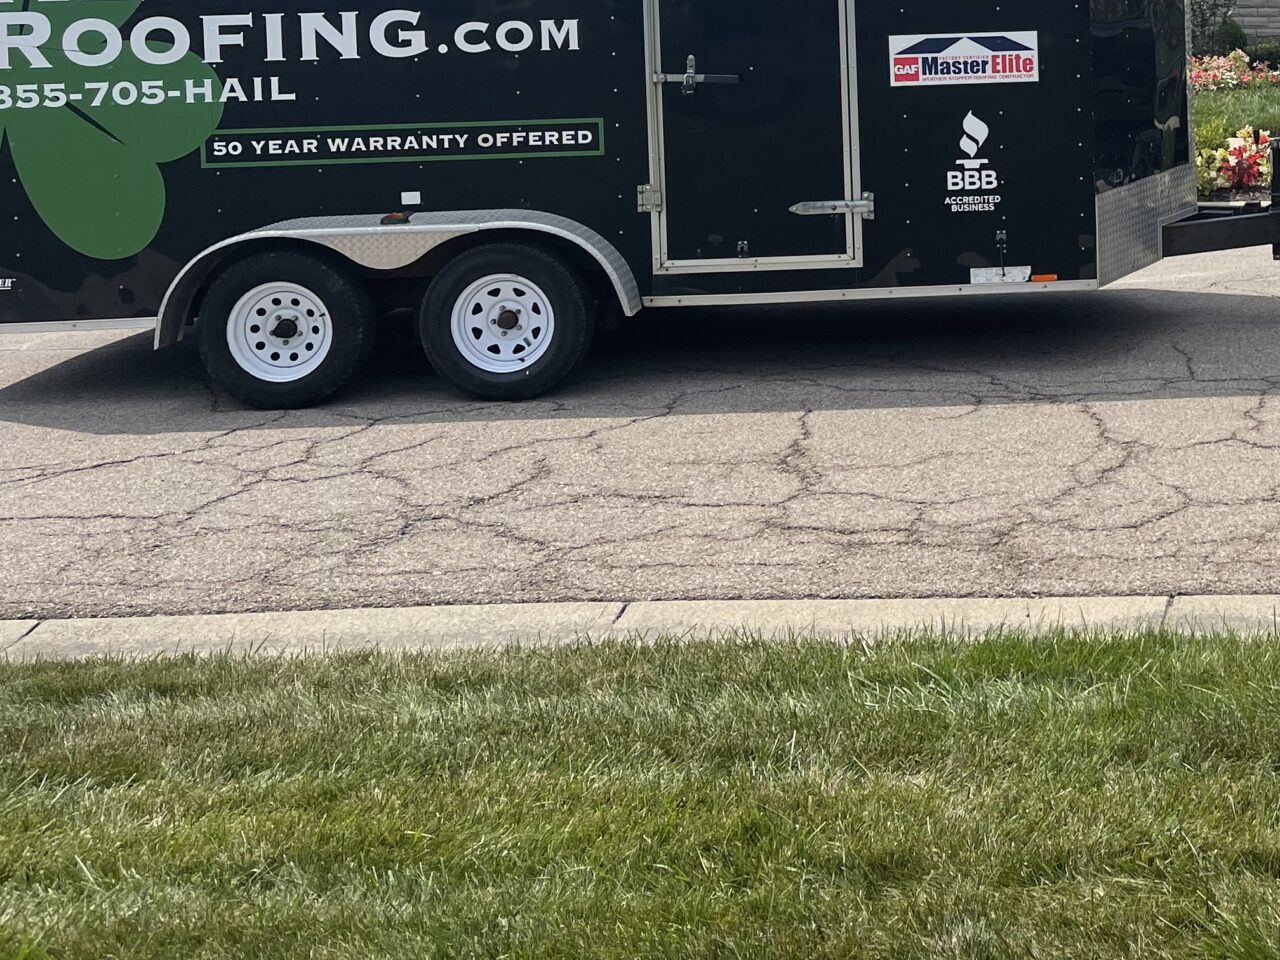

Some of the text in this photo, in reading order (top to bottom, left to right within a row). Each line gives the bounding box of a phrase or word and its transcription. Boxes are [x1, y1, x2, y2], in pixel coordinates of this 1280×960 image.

[895, 64, 919, 75] GAF
[922, 54, 1034, 75] Master Elite
[213, 130, 593, 156] 50 YEAR WARRANTY OFFERED
[947, 170, 998, 191] BBB
[944, 195, 1001, 205] ACCREDITED
[951, 203, 995, 212] BUSINESS
